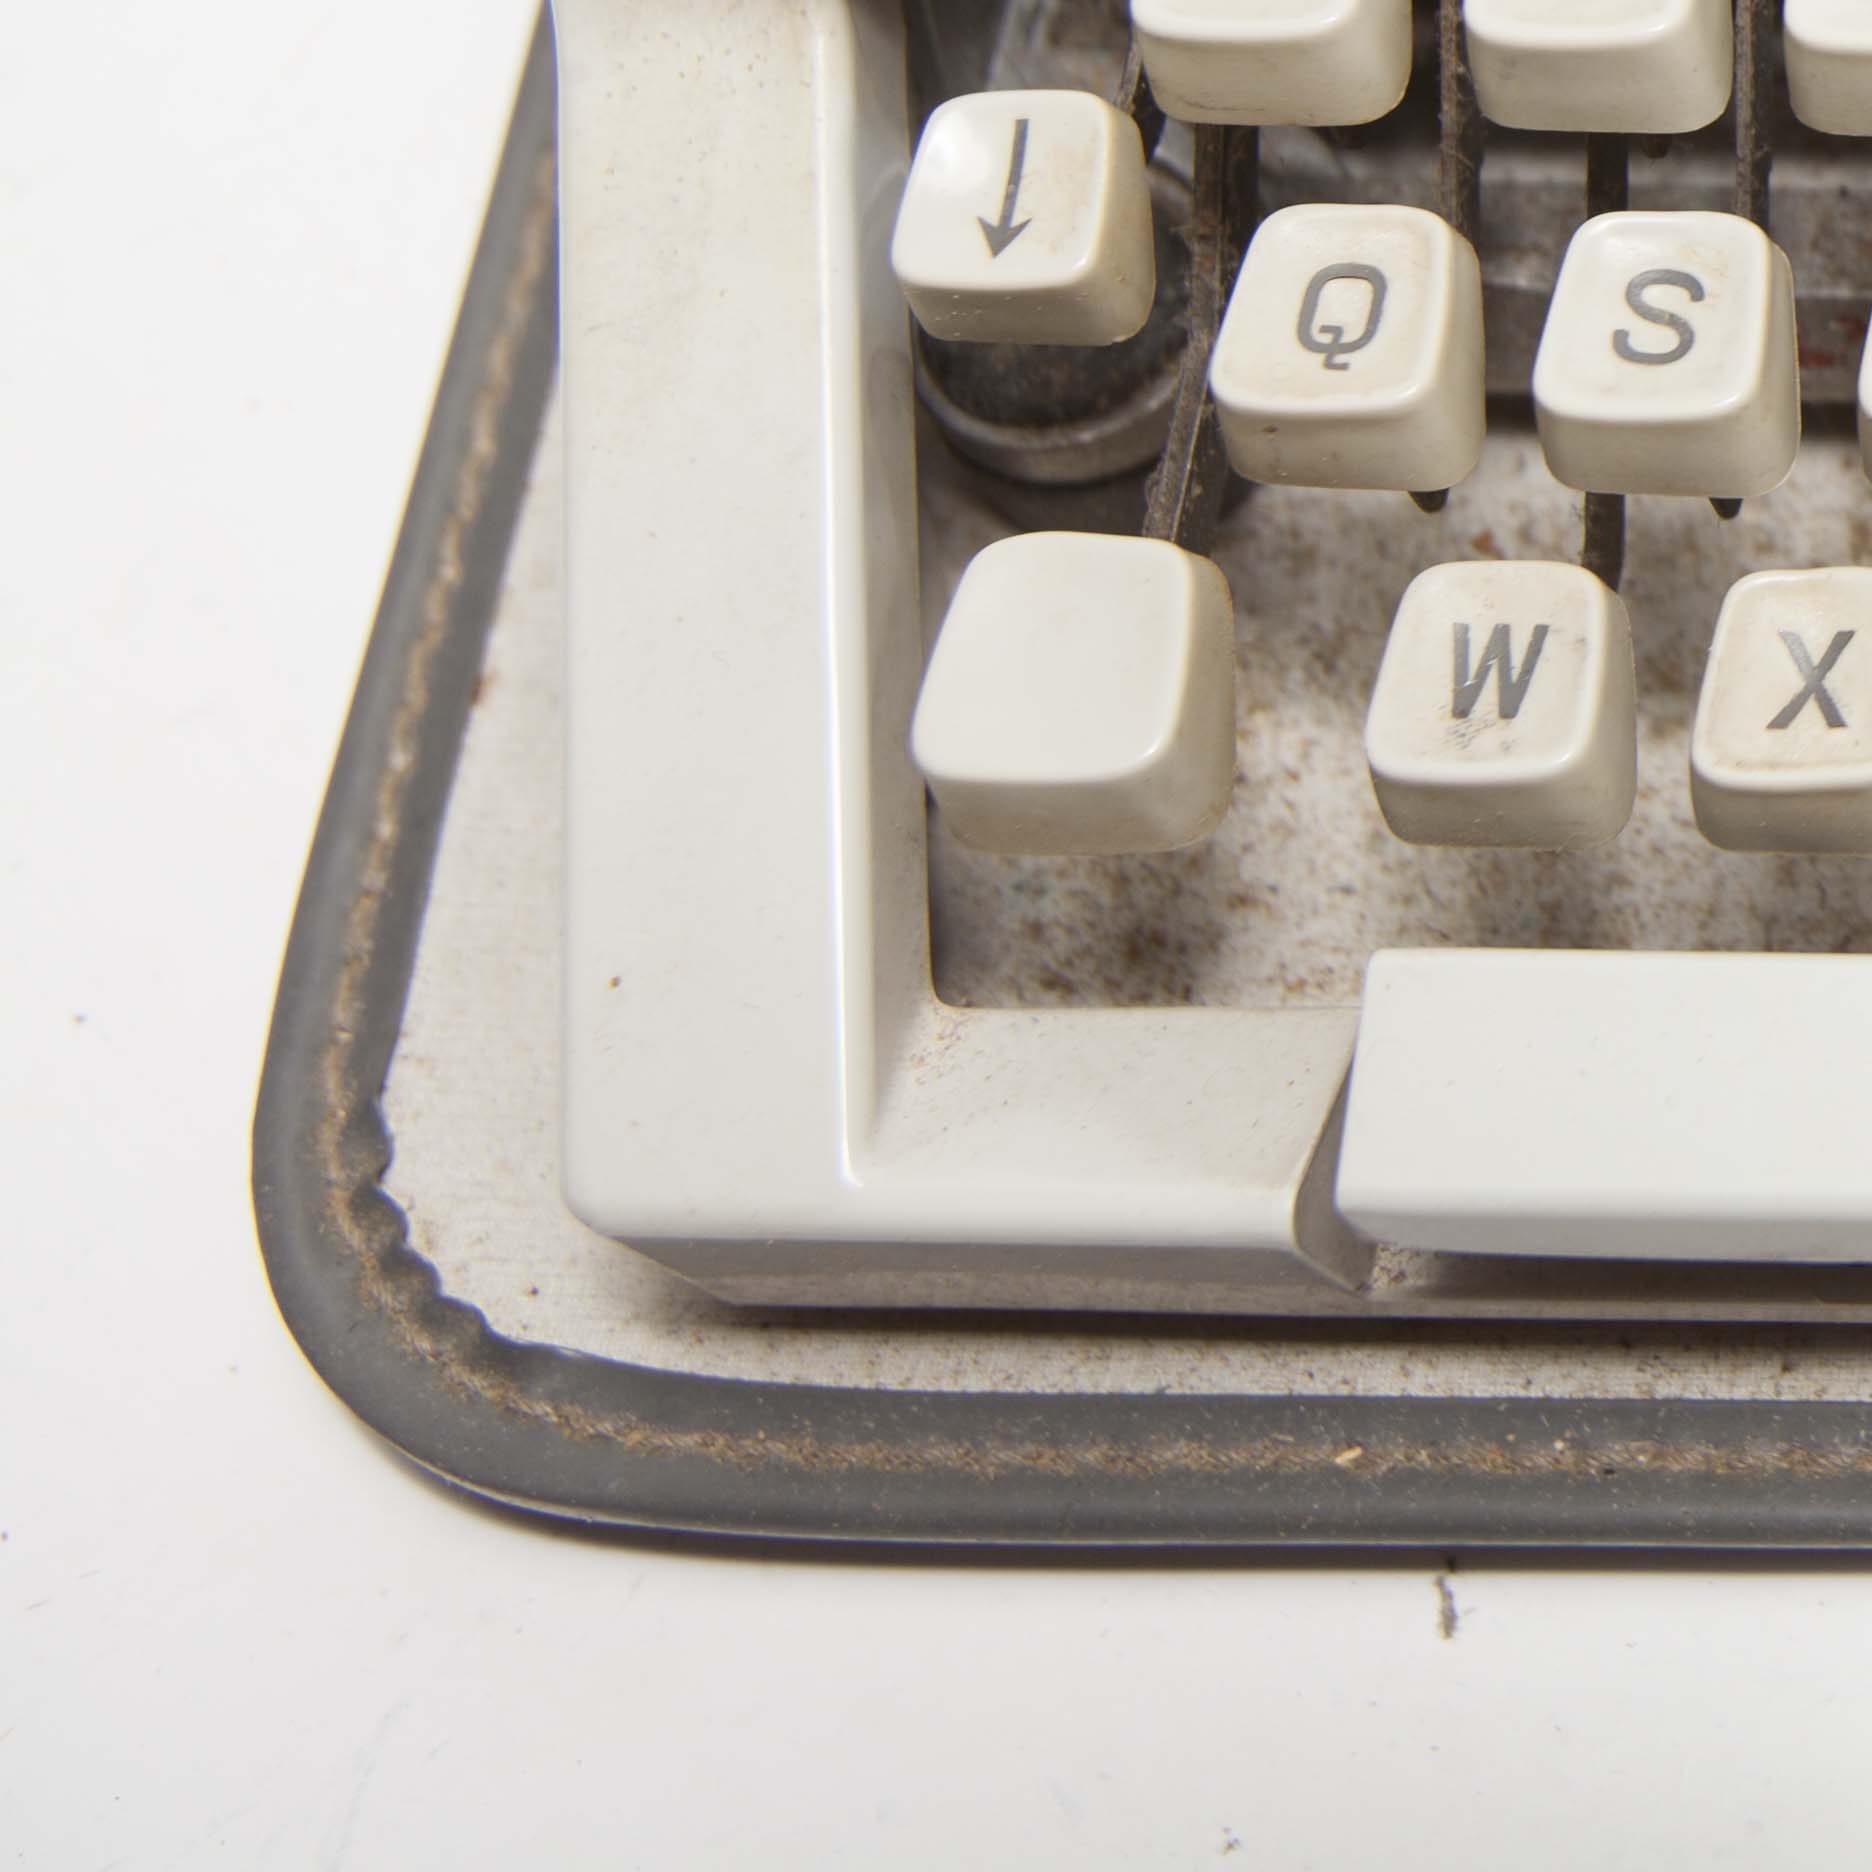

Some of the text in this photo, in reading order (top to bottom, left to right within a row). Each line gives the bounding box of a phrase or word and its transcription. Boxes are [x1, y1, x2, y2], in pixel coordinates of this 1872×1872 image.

[1294, 260, 1390, 373] Q
[1610, 267, 1707, 368] S
[1449, 622, 1552, 725] W
[1764, 628, 1858, 732] X
